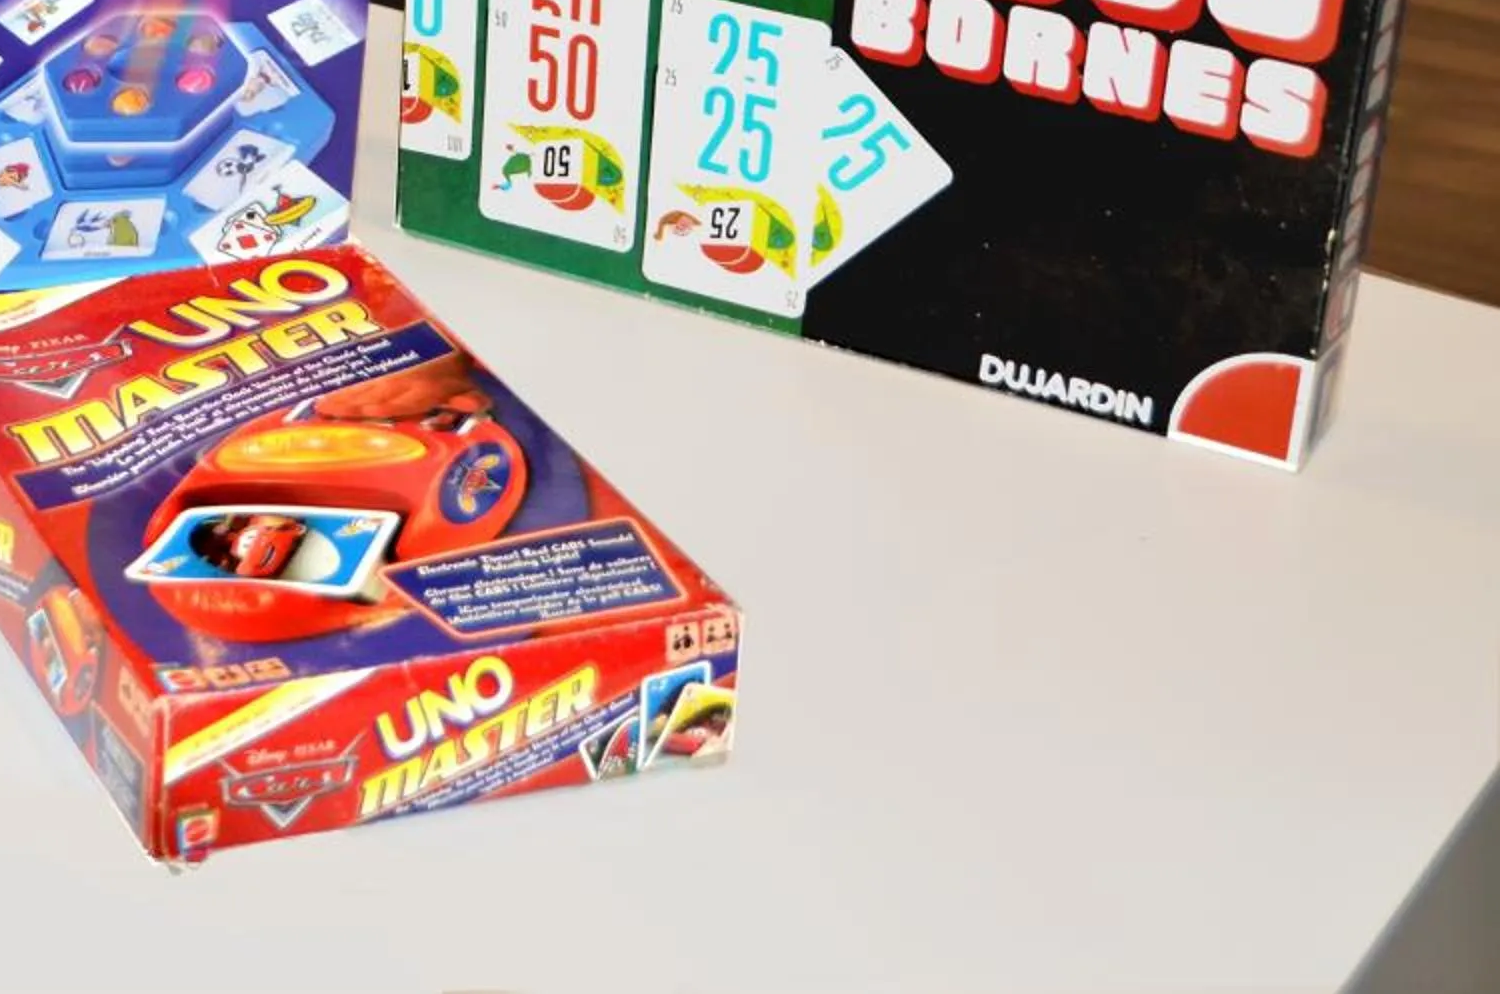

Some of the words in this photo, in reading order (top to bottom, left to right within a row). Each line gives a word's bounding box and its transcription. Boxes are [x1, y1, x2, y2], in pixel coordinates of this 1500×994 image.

[527, 24, 598, 121] 50
[707, 13, 783, 87] 25
[543, 145, 572, 177] 50
[697, 86, 778, 183] 25
[821, 93, 912, 192] 25
[709, 207, 741, 239] 25
[129, 258, 349, 349] UNO
[5, 301, 383, 465] MASTER
[978, 353, 1153, 425] DUJARDIN
[360, 665, 597, 816] MASTER
[375, 655, 513, 760] UNO
